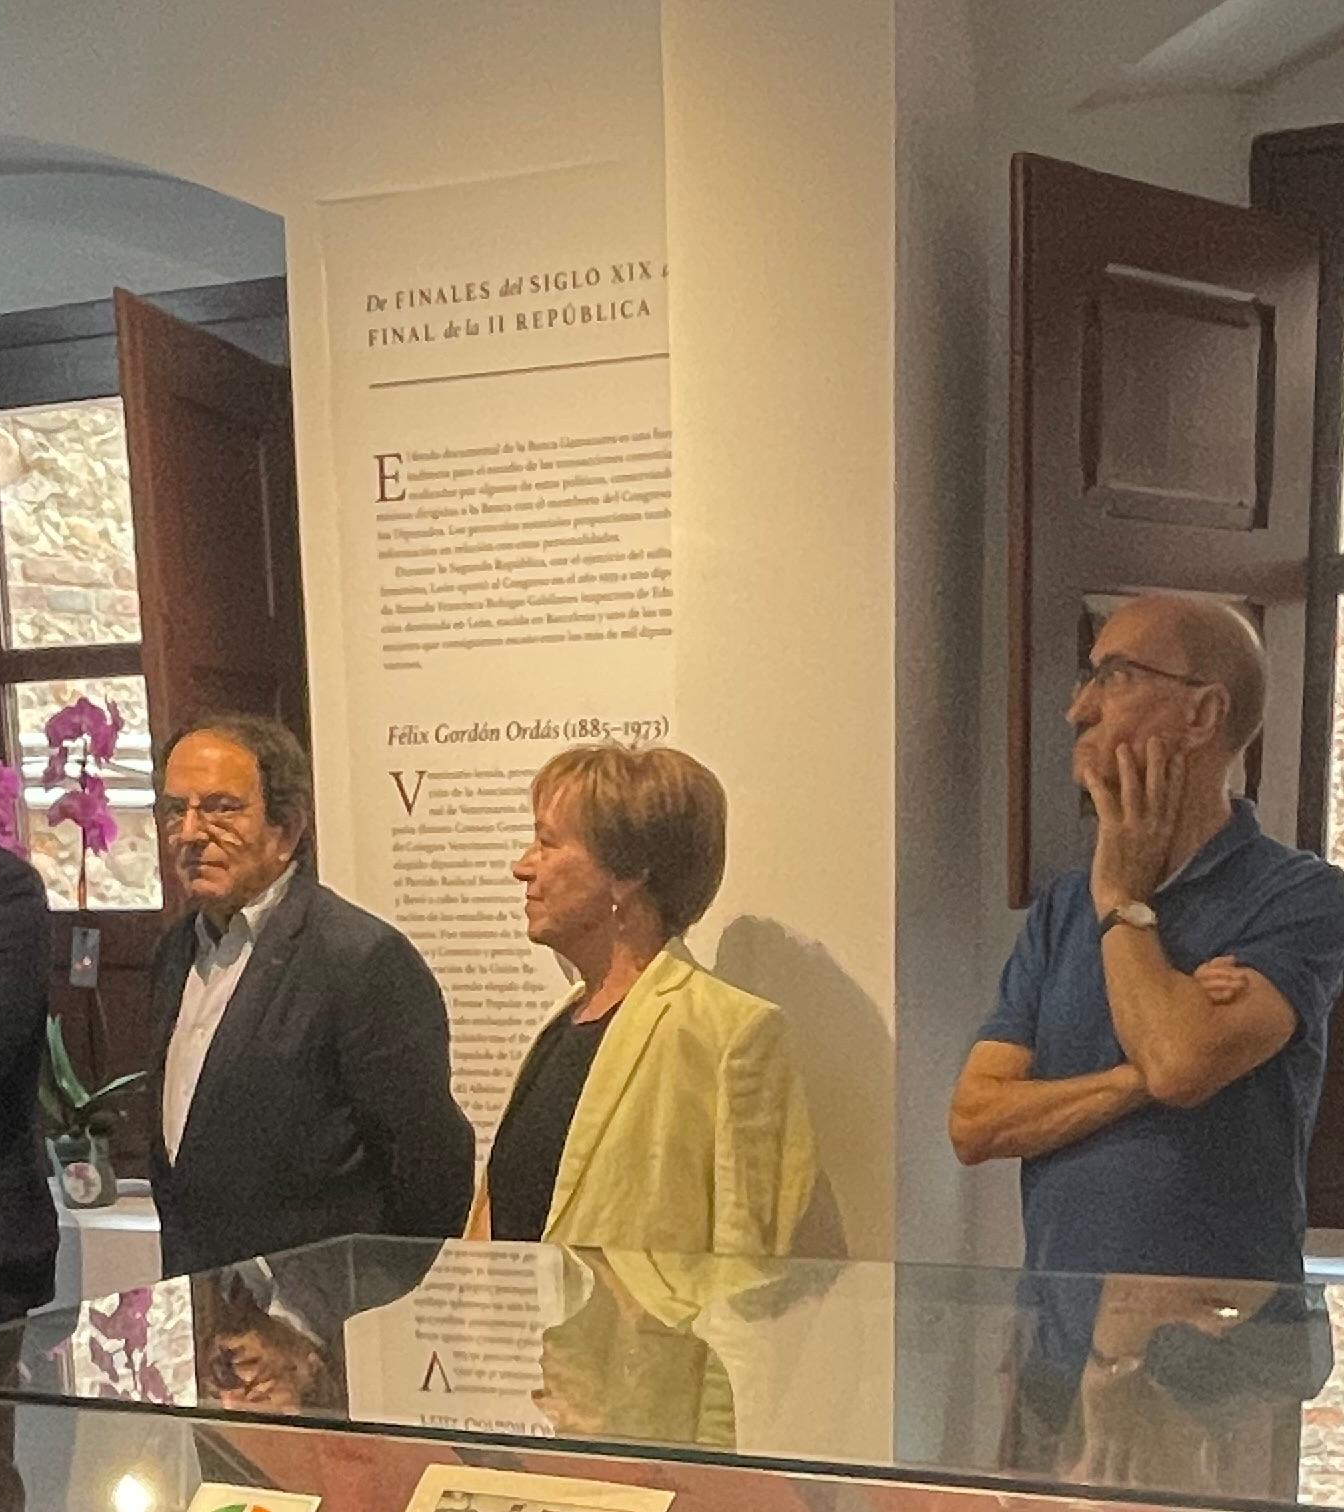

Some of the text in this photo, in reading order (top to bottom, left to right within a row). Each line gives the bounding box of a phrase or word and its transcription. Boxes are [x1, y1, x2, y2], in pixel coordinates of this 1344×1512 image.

[366, 294, 387, 313] De
[396, 281, 490, 308] FINALES
[499, 279, 522, 297] del
[530, 267, 600, 294] SIGLO
[611, 260, 652, 283] XIX
[368, 323, 436, 348] FINAL
[488, 315, 504, 335] II
[516, 297, 650, 331] REPÚBLICA
[388, 723, 429, 746] Félix
[435, 720, 500, 745] Gordón
[506, 716, 559, 742] Ordás
